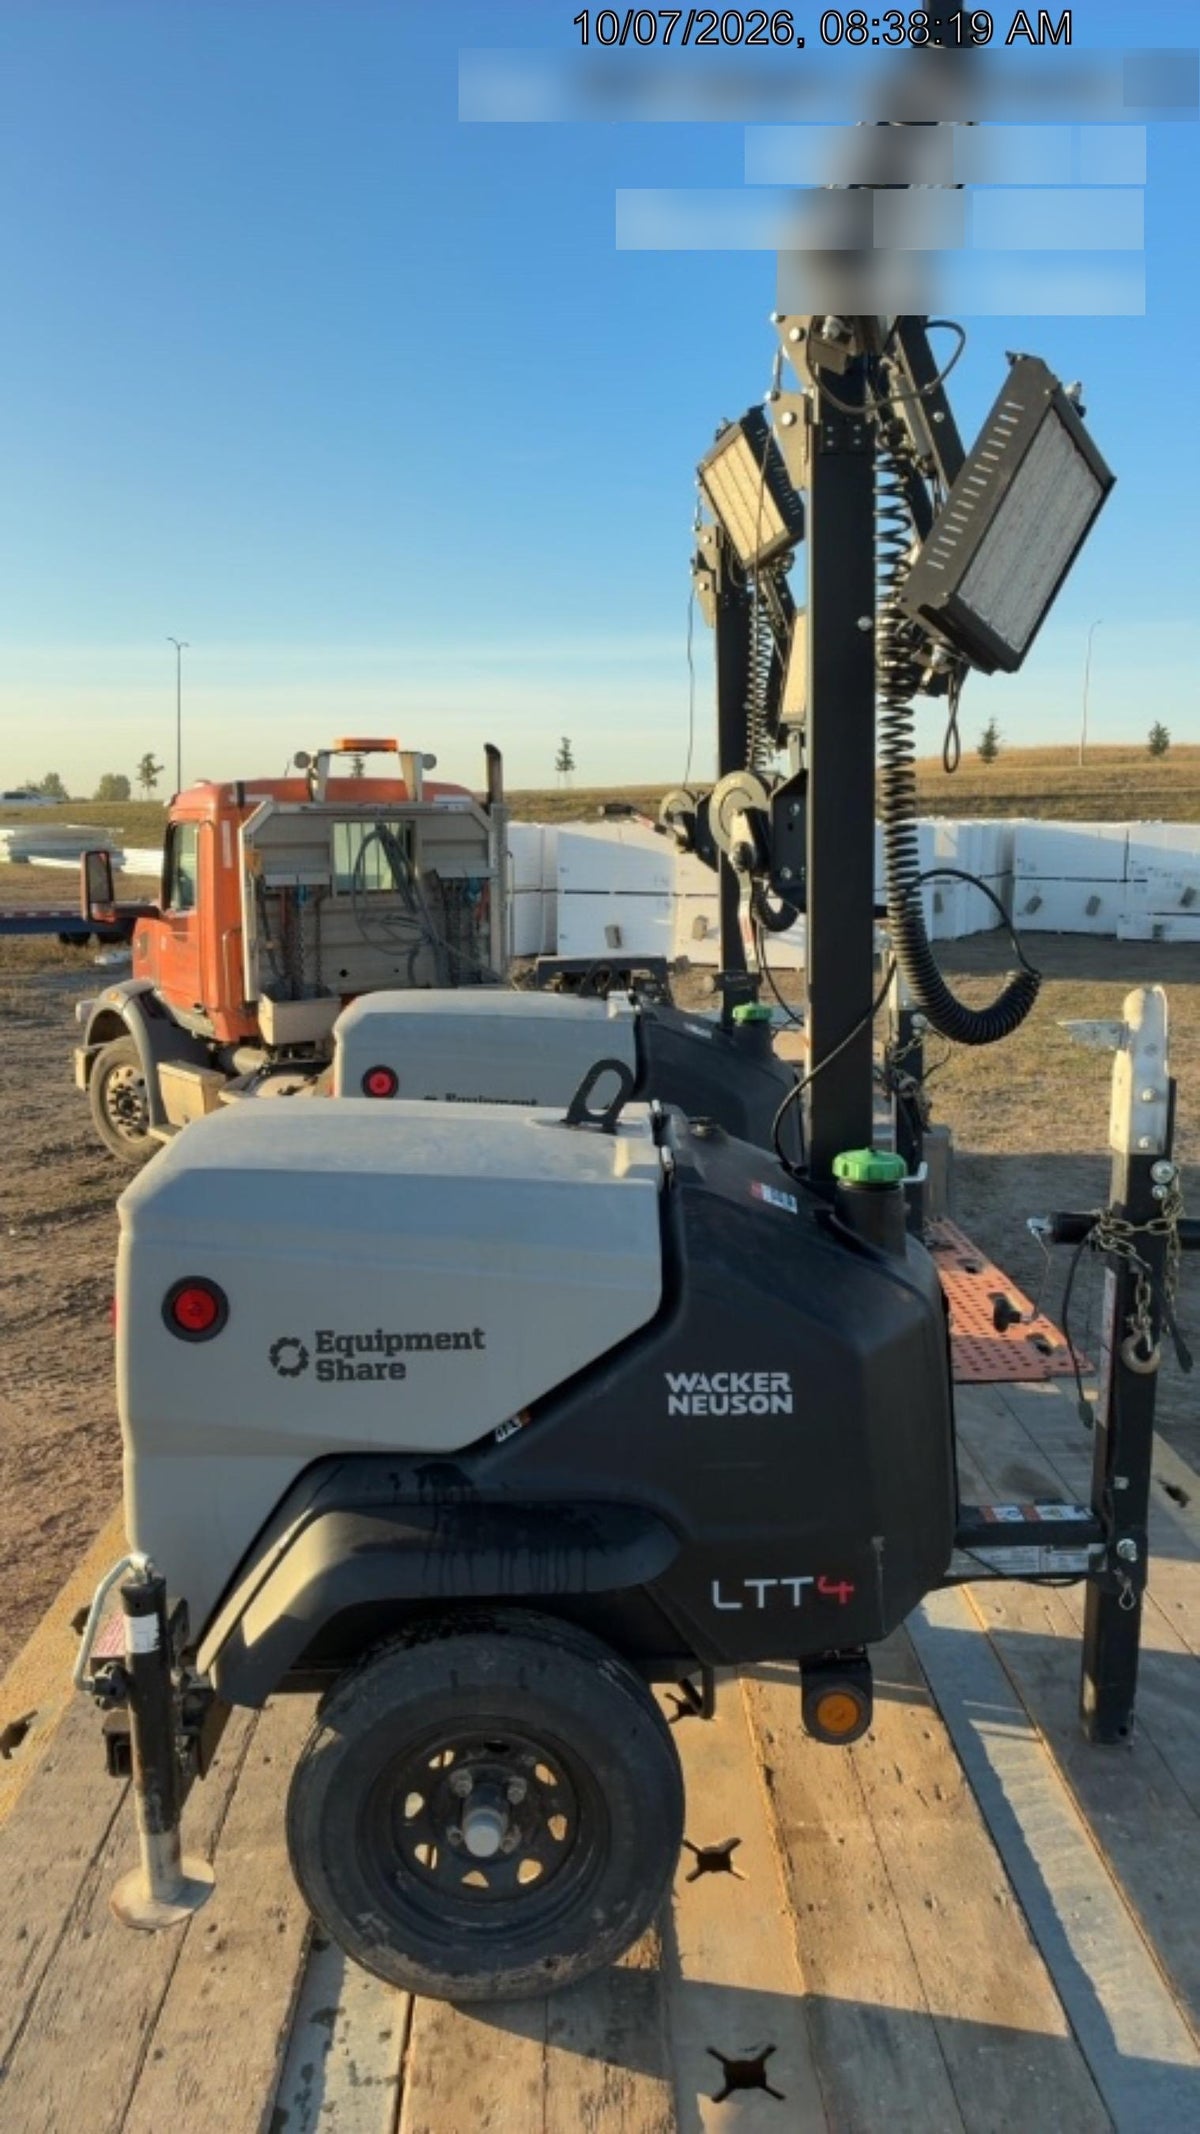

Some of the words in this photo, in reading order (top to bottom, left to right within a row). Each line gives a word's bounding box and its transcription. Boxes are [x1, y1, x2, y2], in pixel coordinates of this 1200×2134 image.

[315, 1327, 486, 1358] Equipment
[316, 1358, 407, 1382] Share
[664, 1371, 793, 1393] WACKER
[667, 1393, 793, 1416] NEUSON
[711, 1575, 855, 1610] LTT4
